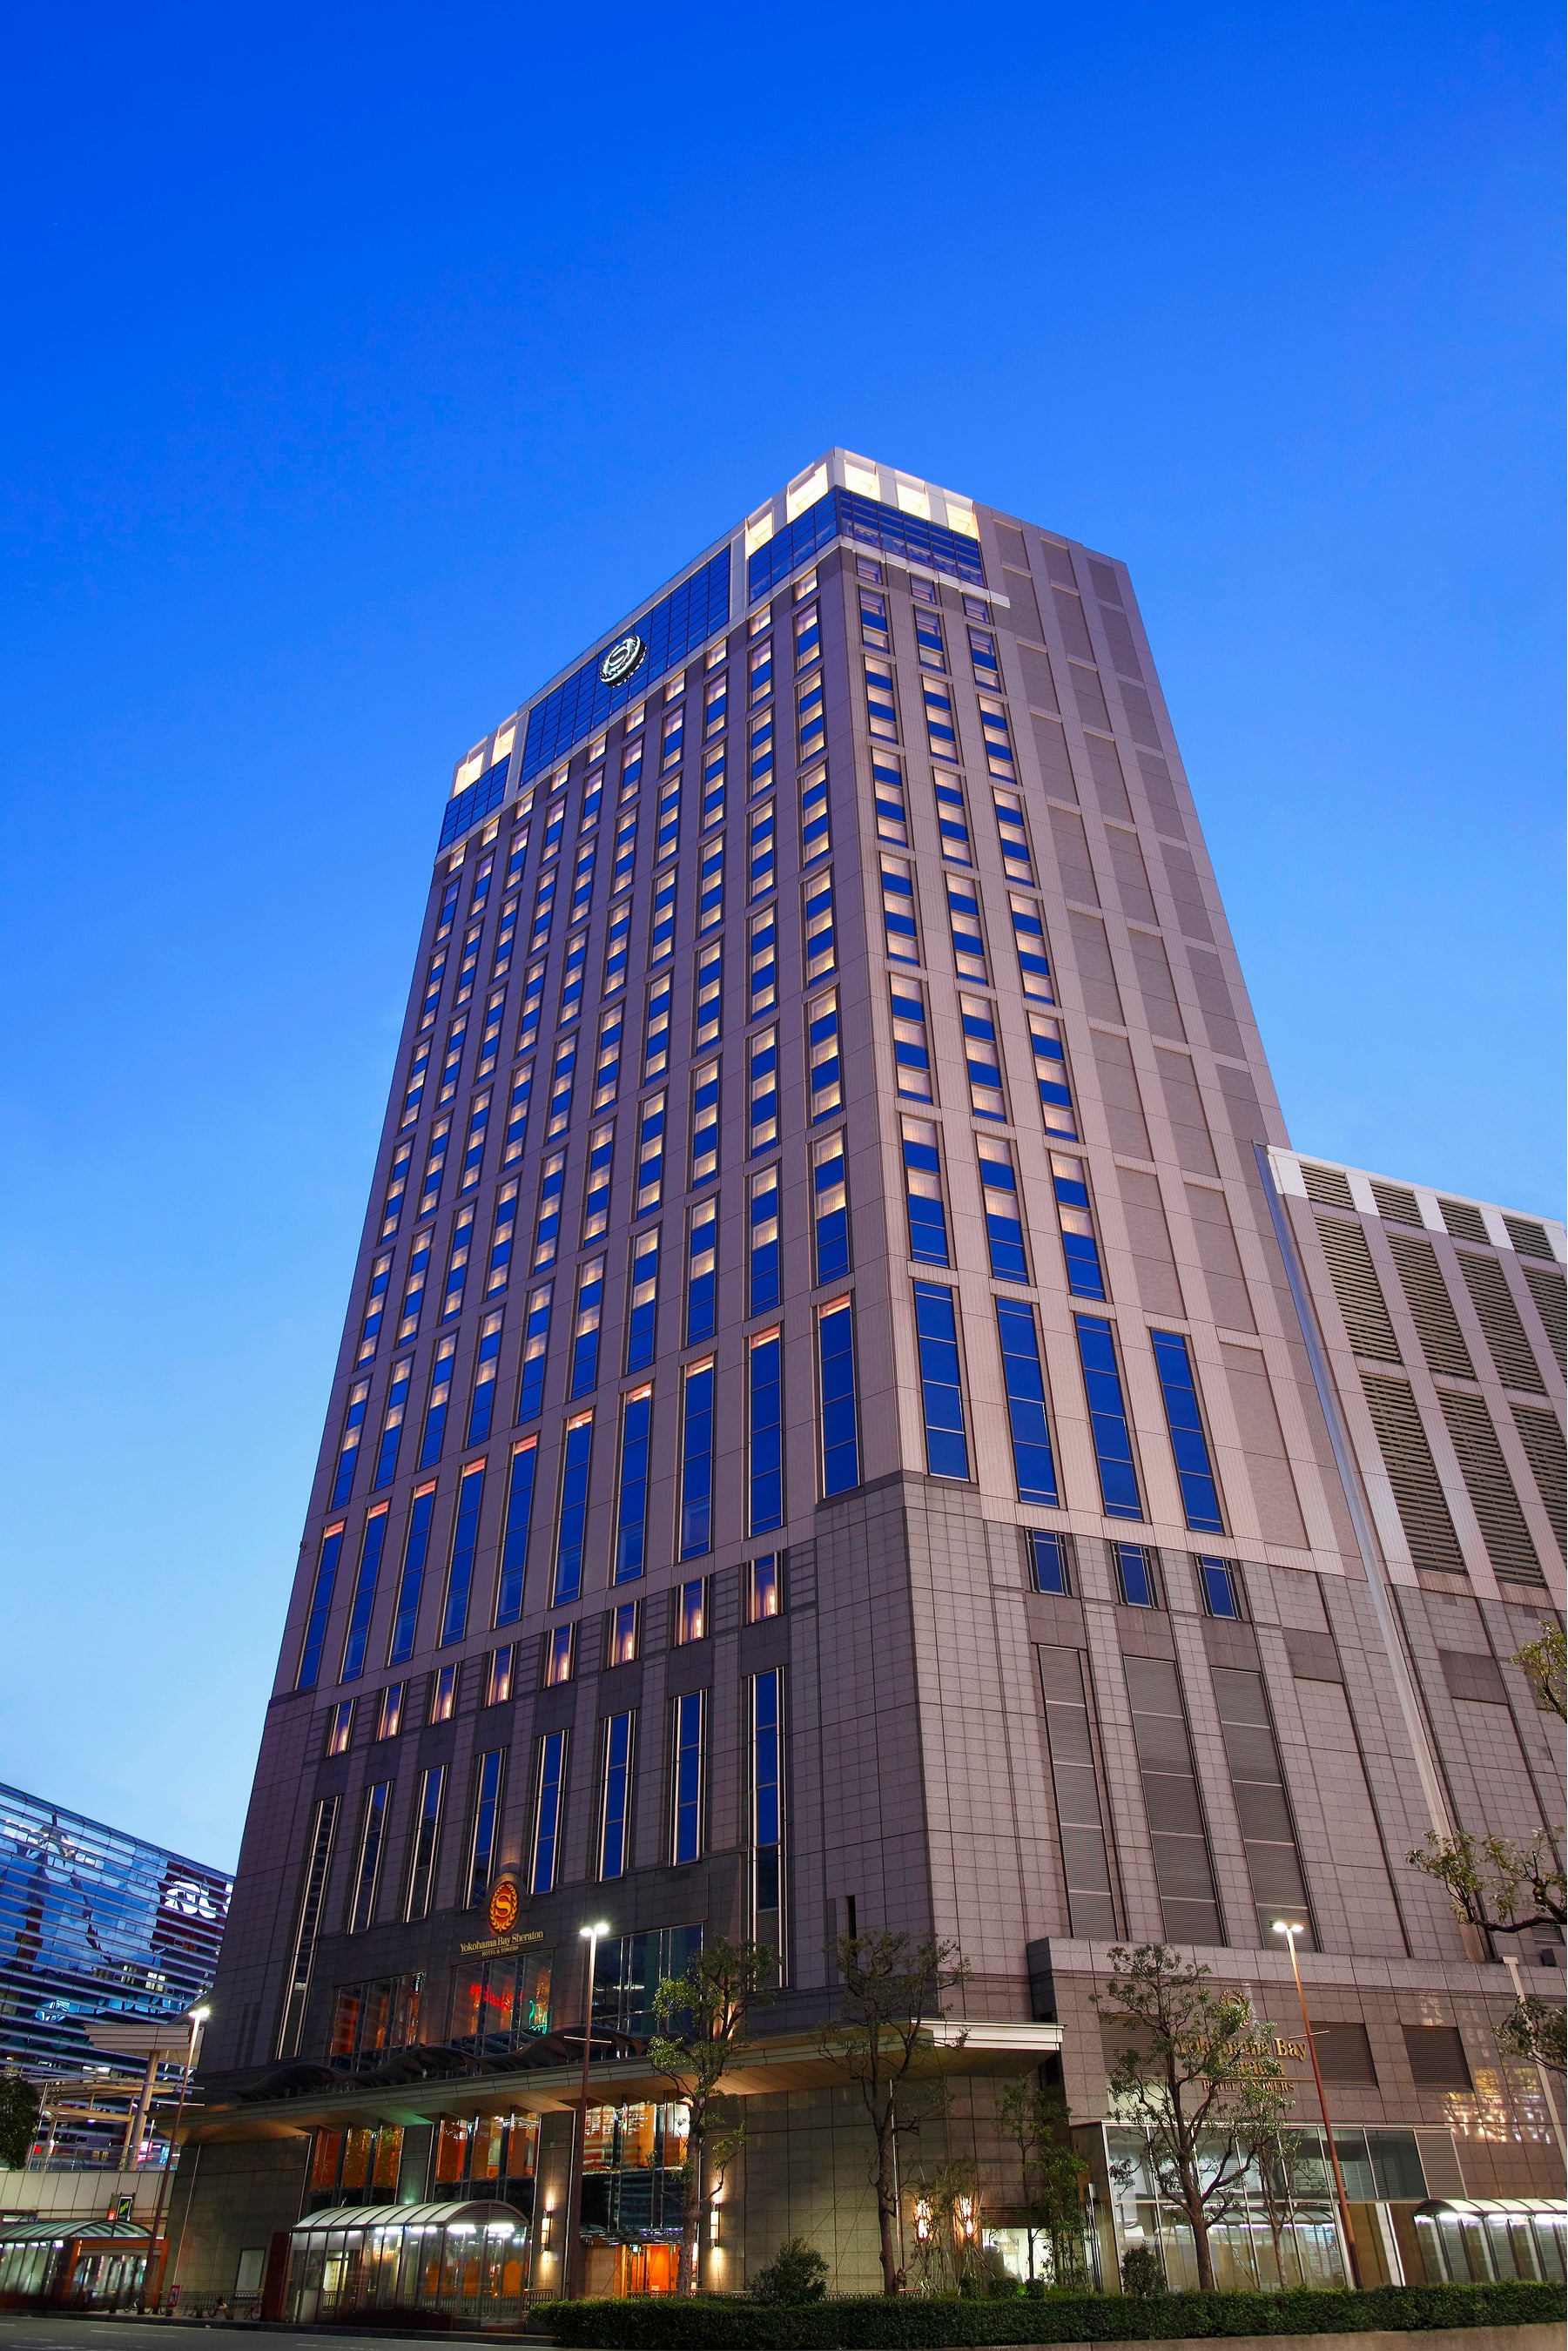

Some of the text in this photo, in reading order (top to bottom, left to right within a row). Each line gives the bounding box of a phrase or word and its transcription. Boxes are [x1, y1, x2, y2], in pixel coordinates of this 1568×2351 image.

[495, 1894, 511, 1917] S
[460, 1930, 544, 1952] Yokohama Bay Sheraton
[481, 1947, 496, 1957] HOTEL
[501, 1945, 519, 1954] TOWERS
[1274, 2038, 1307, 2062] Bay
[1202, 2079, 1238, 2091] HTEL
